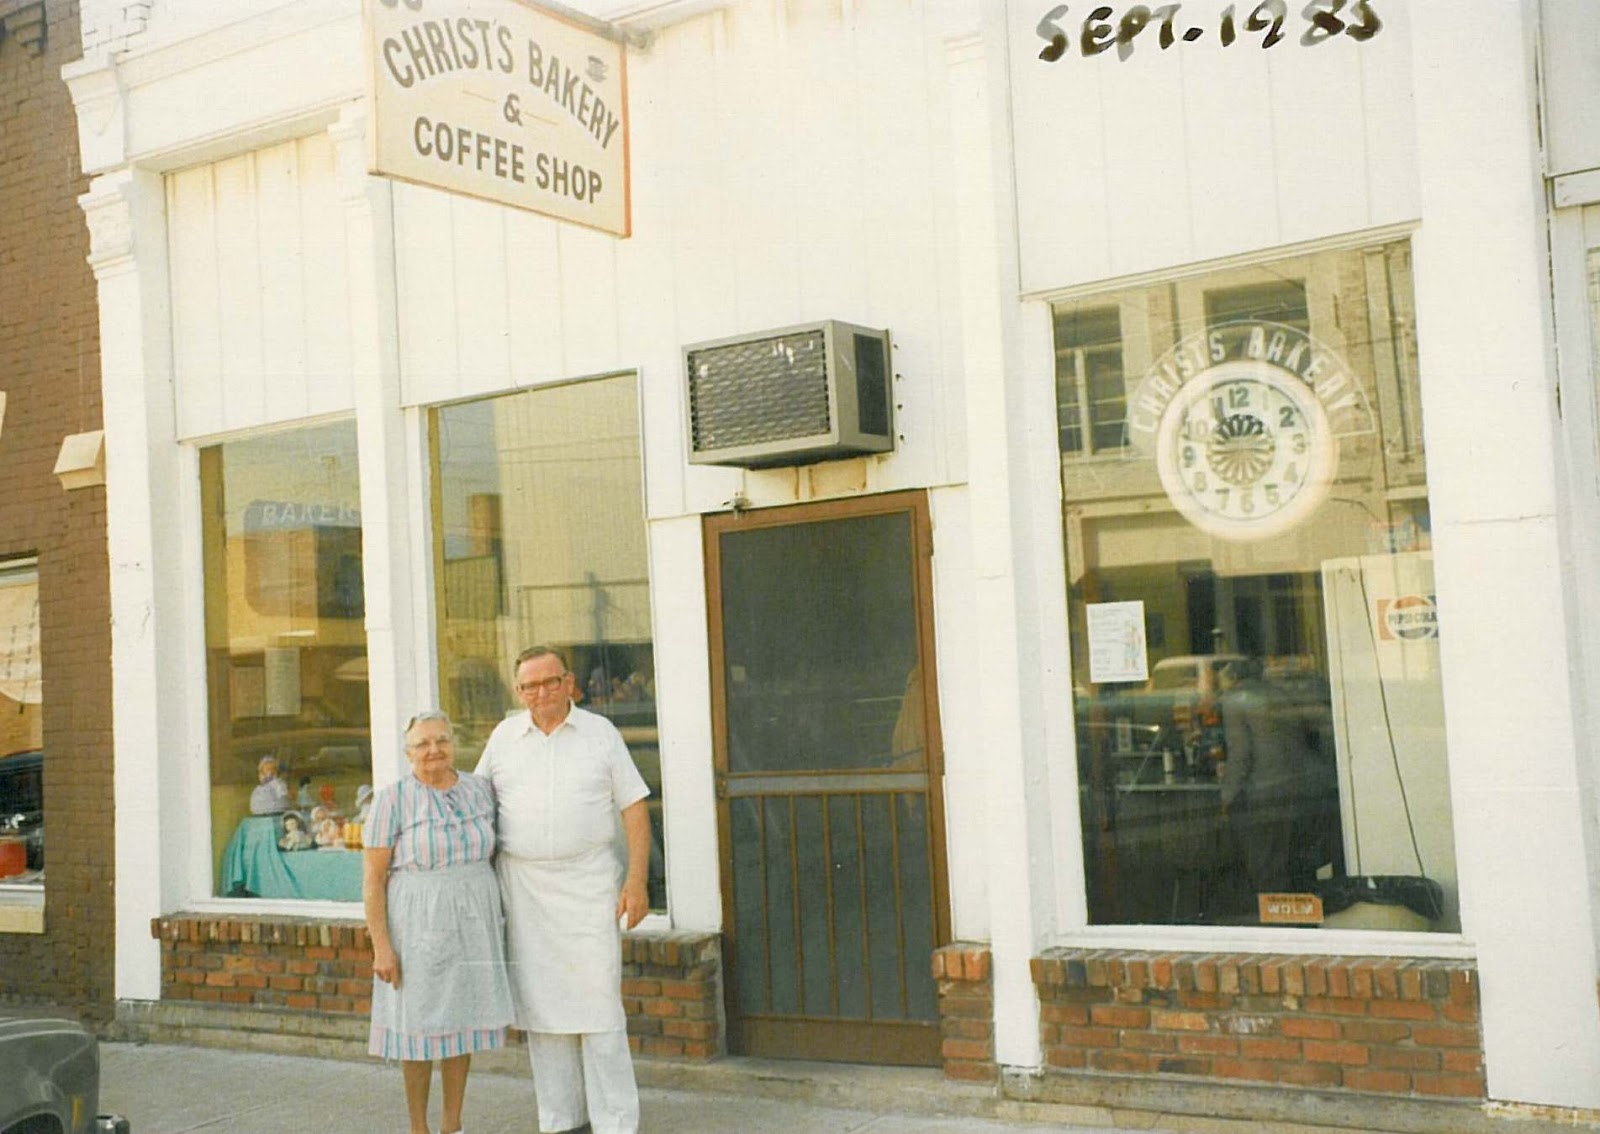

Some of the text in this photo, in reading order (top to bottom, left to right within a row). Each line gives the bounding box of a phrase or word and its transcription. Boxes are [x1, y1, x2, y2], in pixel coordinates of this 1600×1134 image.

[383, 17, 619, 149] CHRIST'S BAKERY
[503, 93, 523, 126] &
[415, 116, 602, 203] COFFEE SHOP
[1248, 326, 1357, 411] BAKERY
[1228, 387, 1250, 409] 12
[1278, 405, 1296, 428] 2
[1292, 432, 1306, 455] 3
[1182, 445, 1196, 468] 9
[1215, 488, 1230, 510] 7
[1264, 483, 1279, 505] 5
